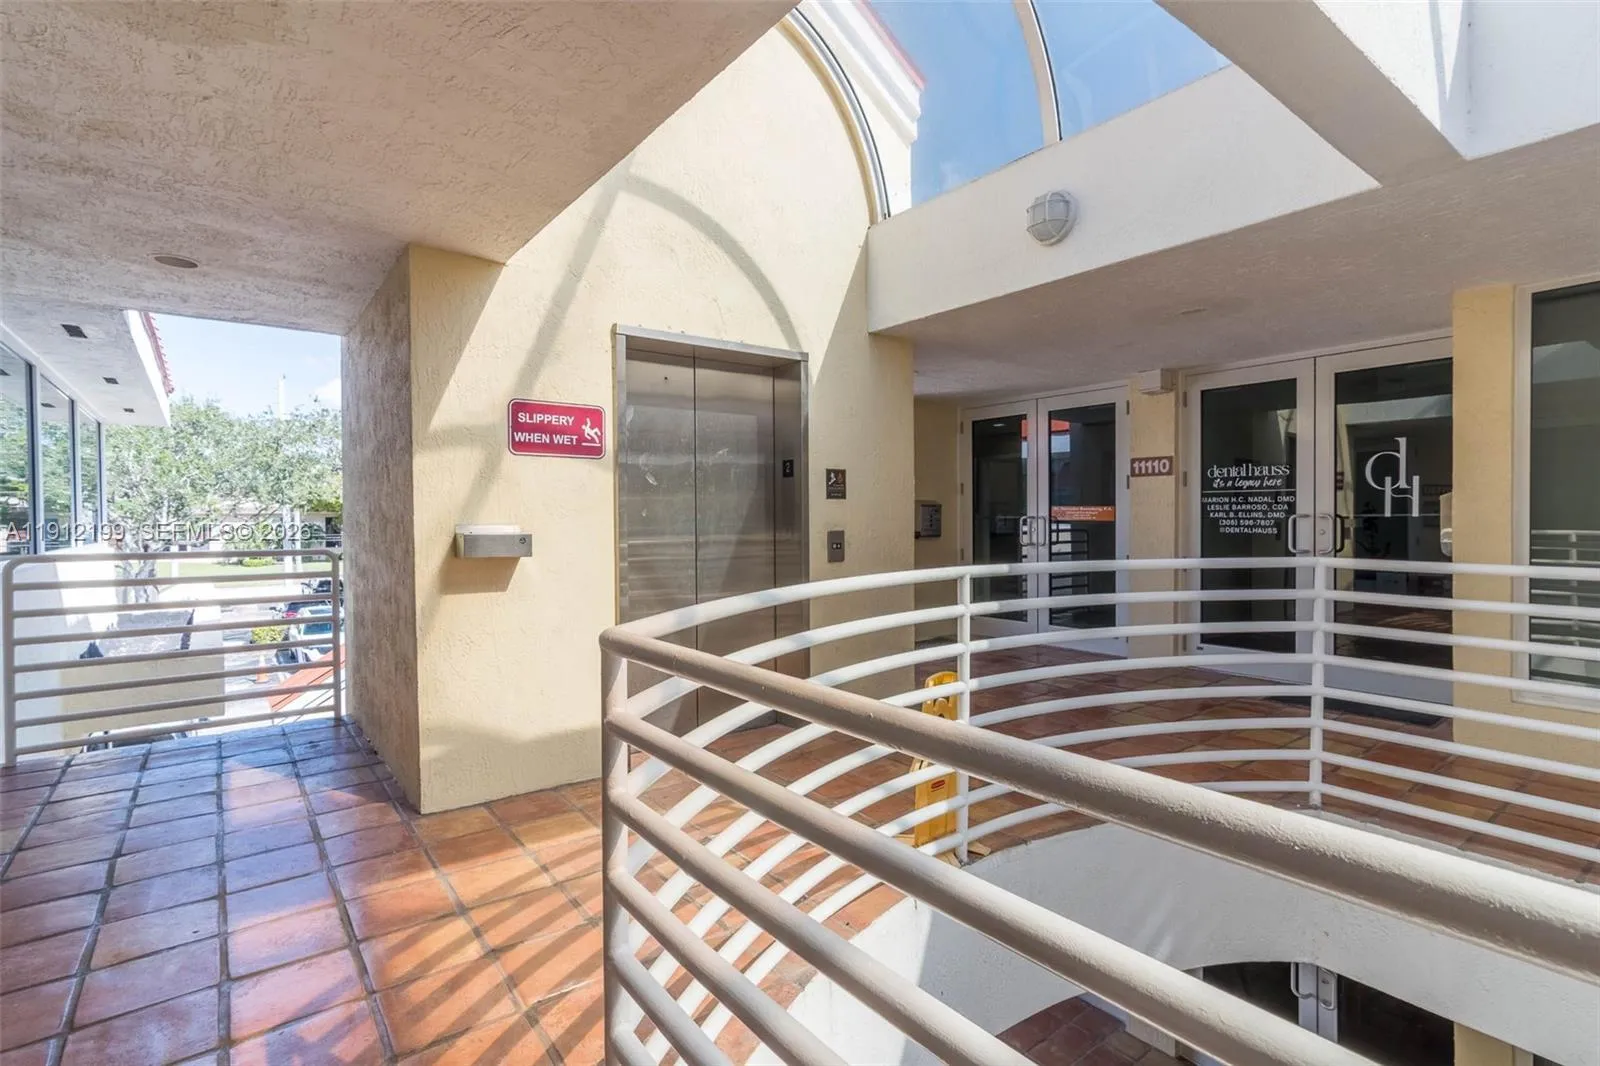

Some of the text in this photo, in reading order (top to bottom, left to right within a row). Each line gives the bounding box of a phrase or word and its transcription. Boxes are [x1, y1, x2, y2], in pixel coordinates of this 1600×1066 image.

[518, 412, 575, 426] SLIPPERY
[514, 432, 578, 445] WHEN WET
[1133, 459, 1170, 474] 11110
[1207, 463, 1290, 478] dental hauss
[1263, 476, 1282, 487] here
